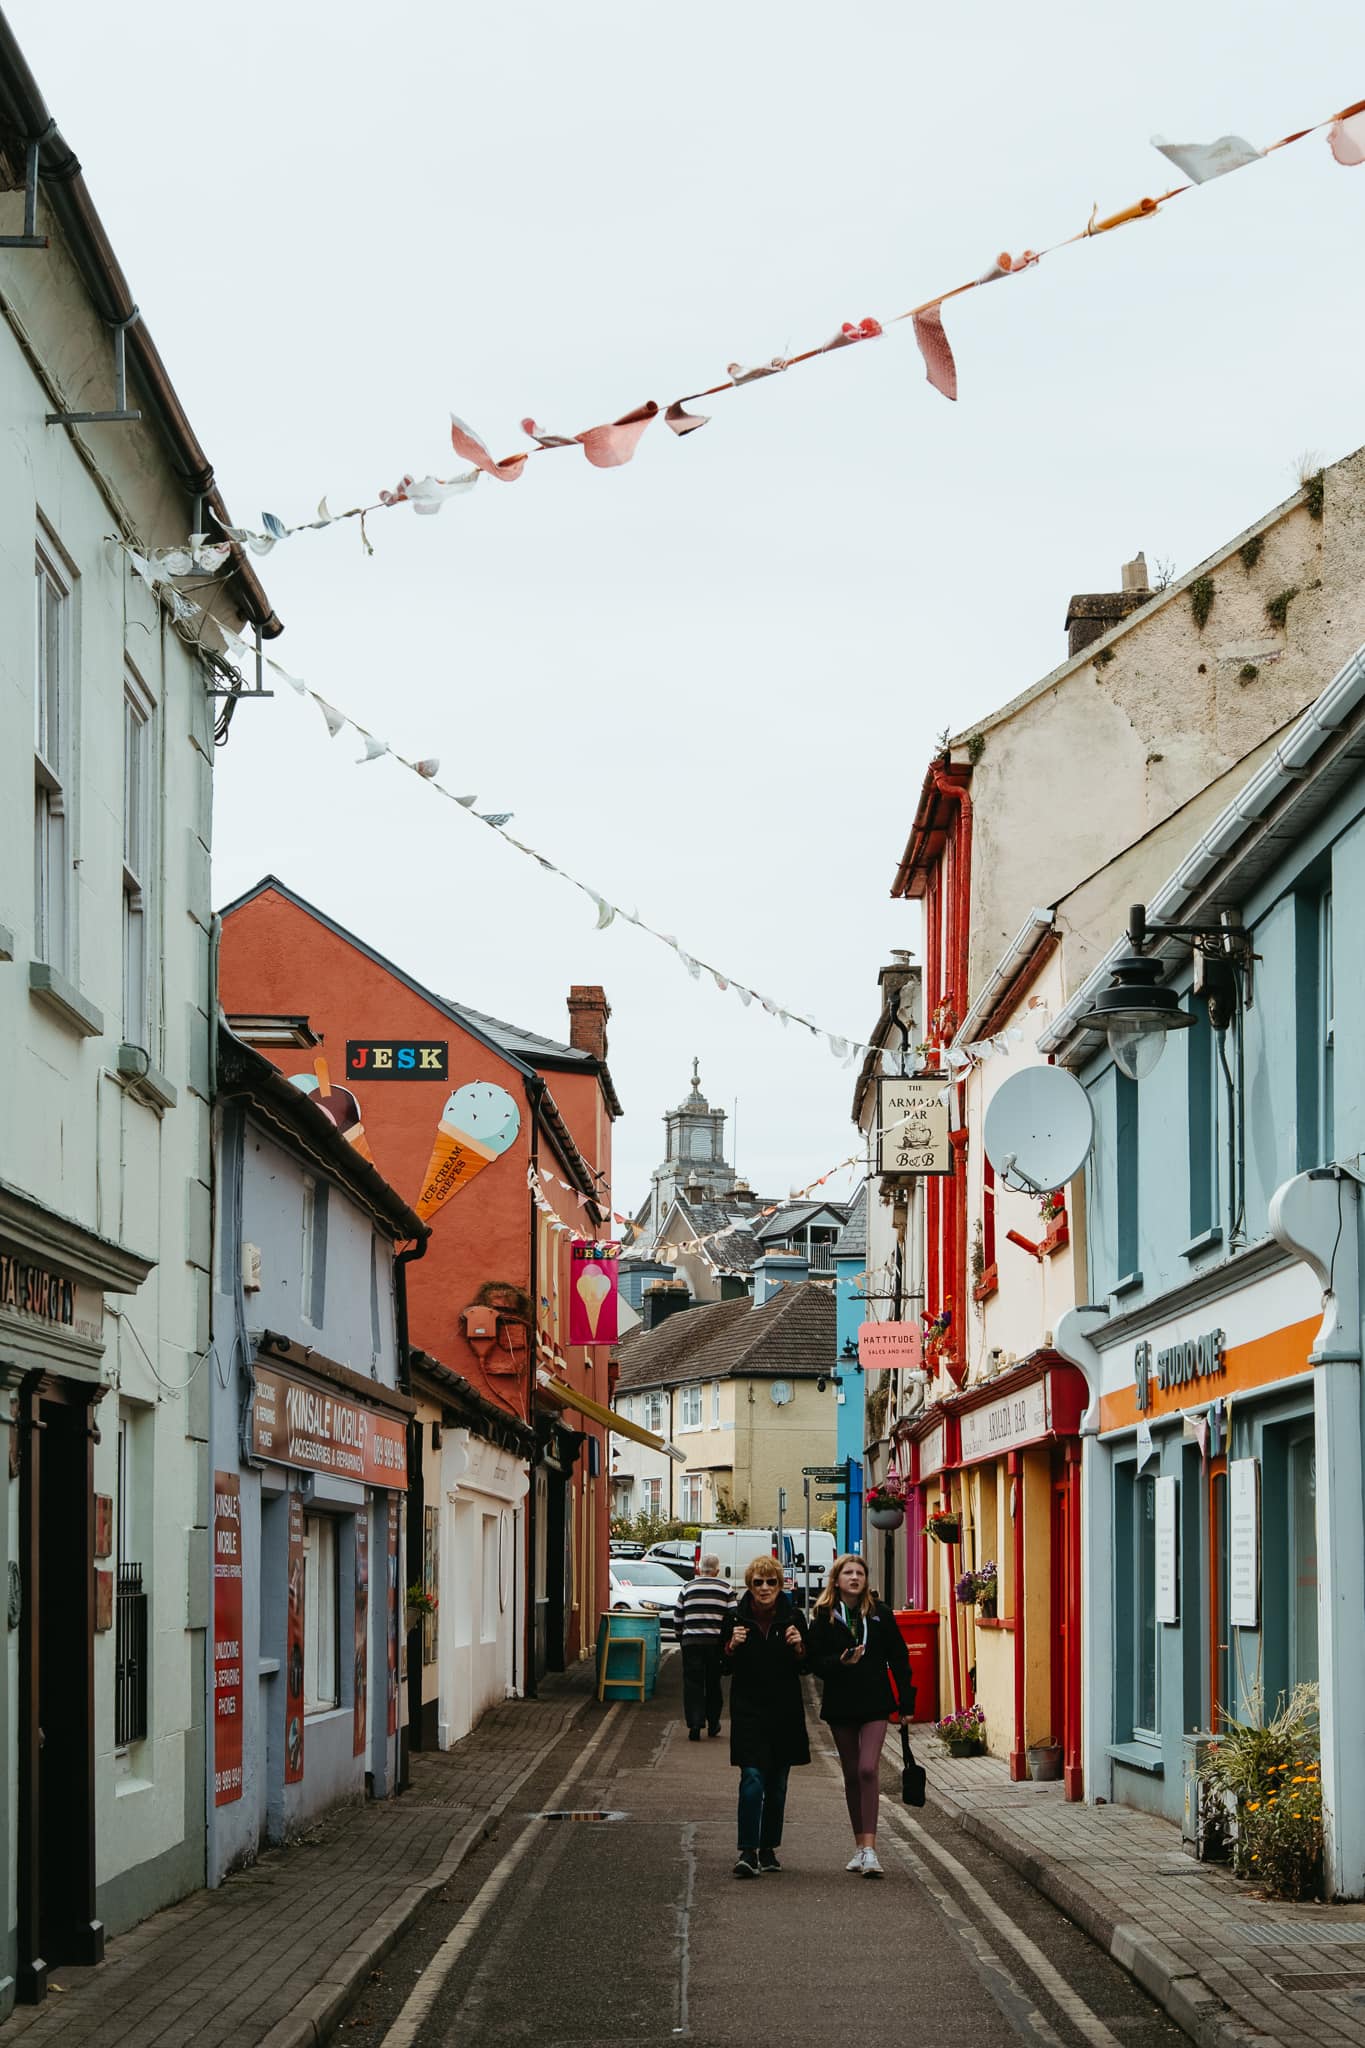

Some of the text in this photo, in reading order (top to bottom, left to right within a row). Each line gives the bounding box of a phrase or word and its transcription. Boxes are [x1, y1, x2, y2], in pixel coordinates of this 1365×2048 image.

[352, 1048, 443, 1069] JESK
[896, 1153, 935, 1168] B&B
[422, 1146, 463, 1203] ICE-CREAM
[436, 1159, 466, 1200] CREPES
[863, 1335, 915, 1344] HATTITUDE
[1157, 1339, 1195, 1391] STUDIO
[1197, 1328, 1222, 1377] ONE
[291, 1387, 364, 1449] KINSALE MOBILE
[1014, 1400, 1027, 1433] BAR
[294, 1437, 331, 1465] ACCESSORIES
[216, 1493, 238, 1519] KINSALE
[217, 1530, 237, 1554] MOBILE
[218, 1696, 236, 1715] PHONES
